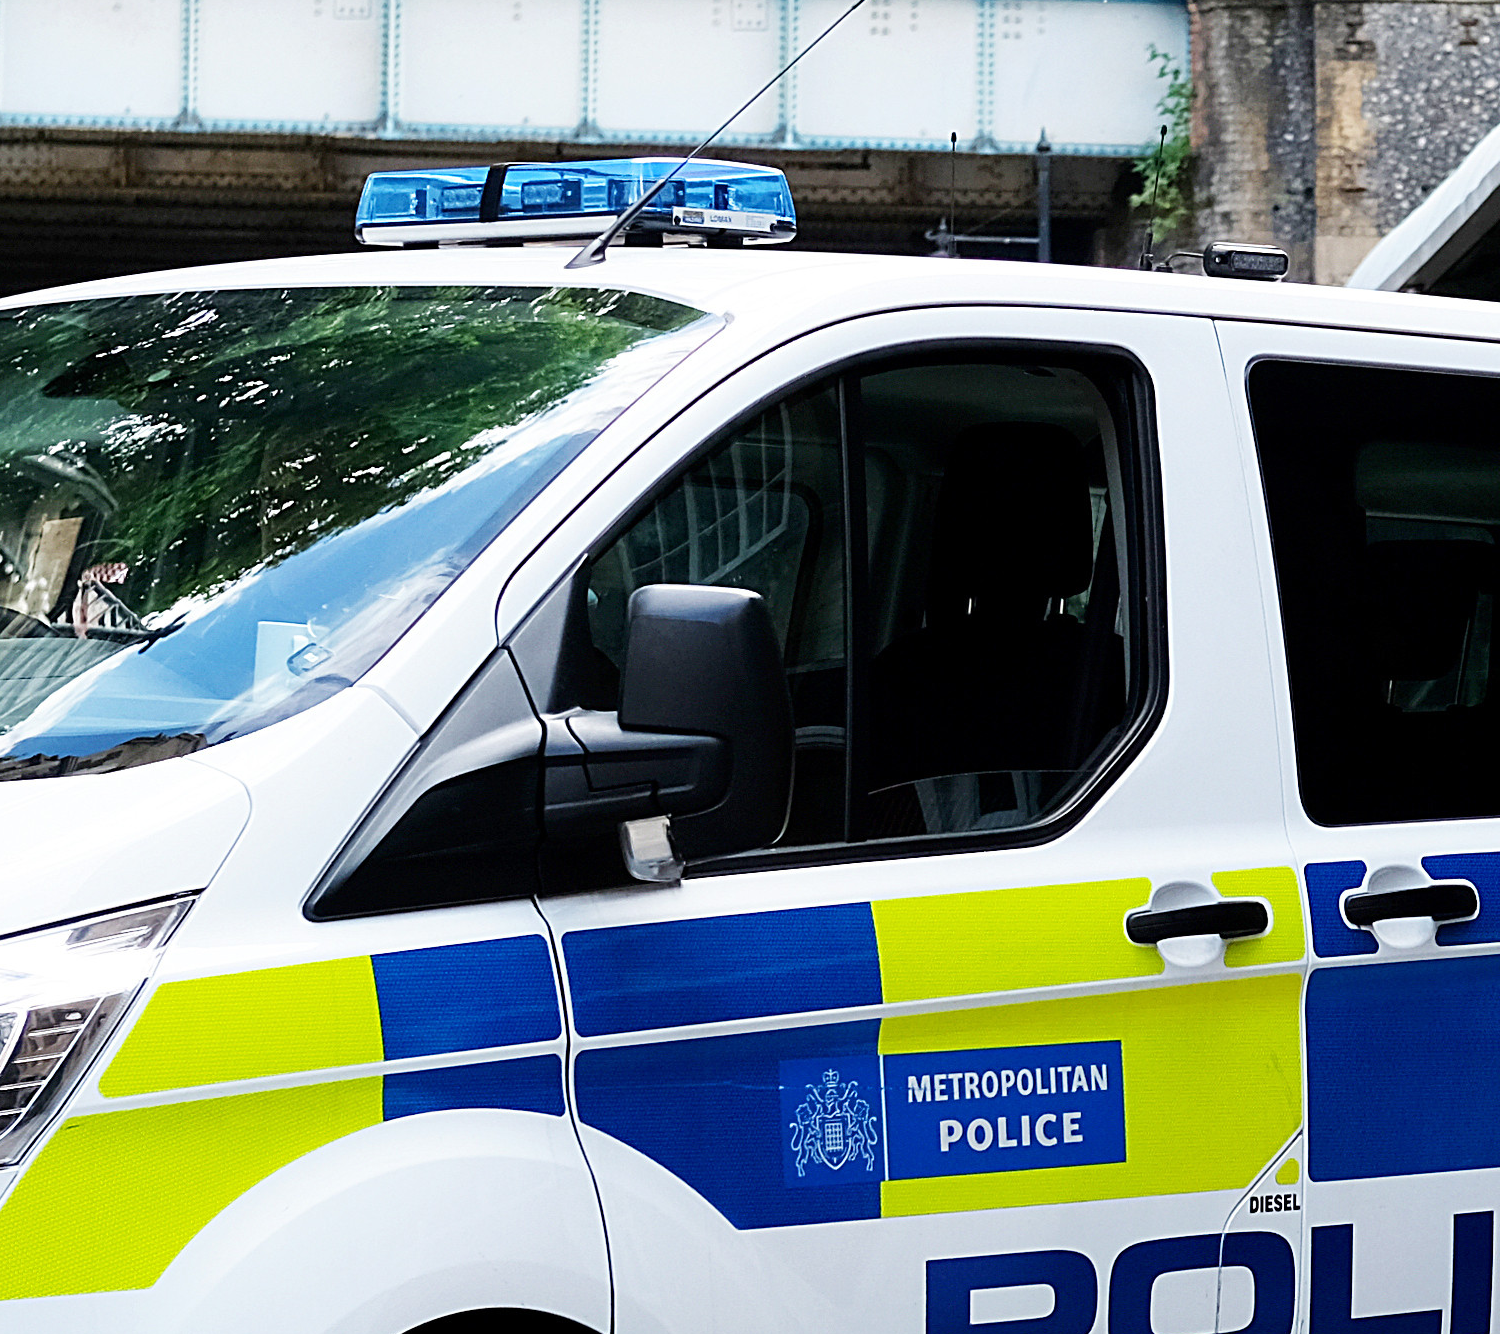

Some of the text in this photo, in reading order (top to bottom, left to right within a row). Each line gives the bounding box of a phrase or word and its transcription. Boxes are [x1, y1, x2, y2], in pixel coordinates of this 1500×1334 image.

[905, 1062, 1111, 1105] METROPOLITAN
[937, 1110, 1085, 1154] POLICE
[1248, 1192, 1302, 1215] DIESEL
